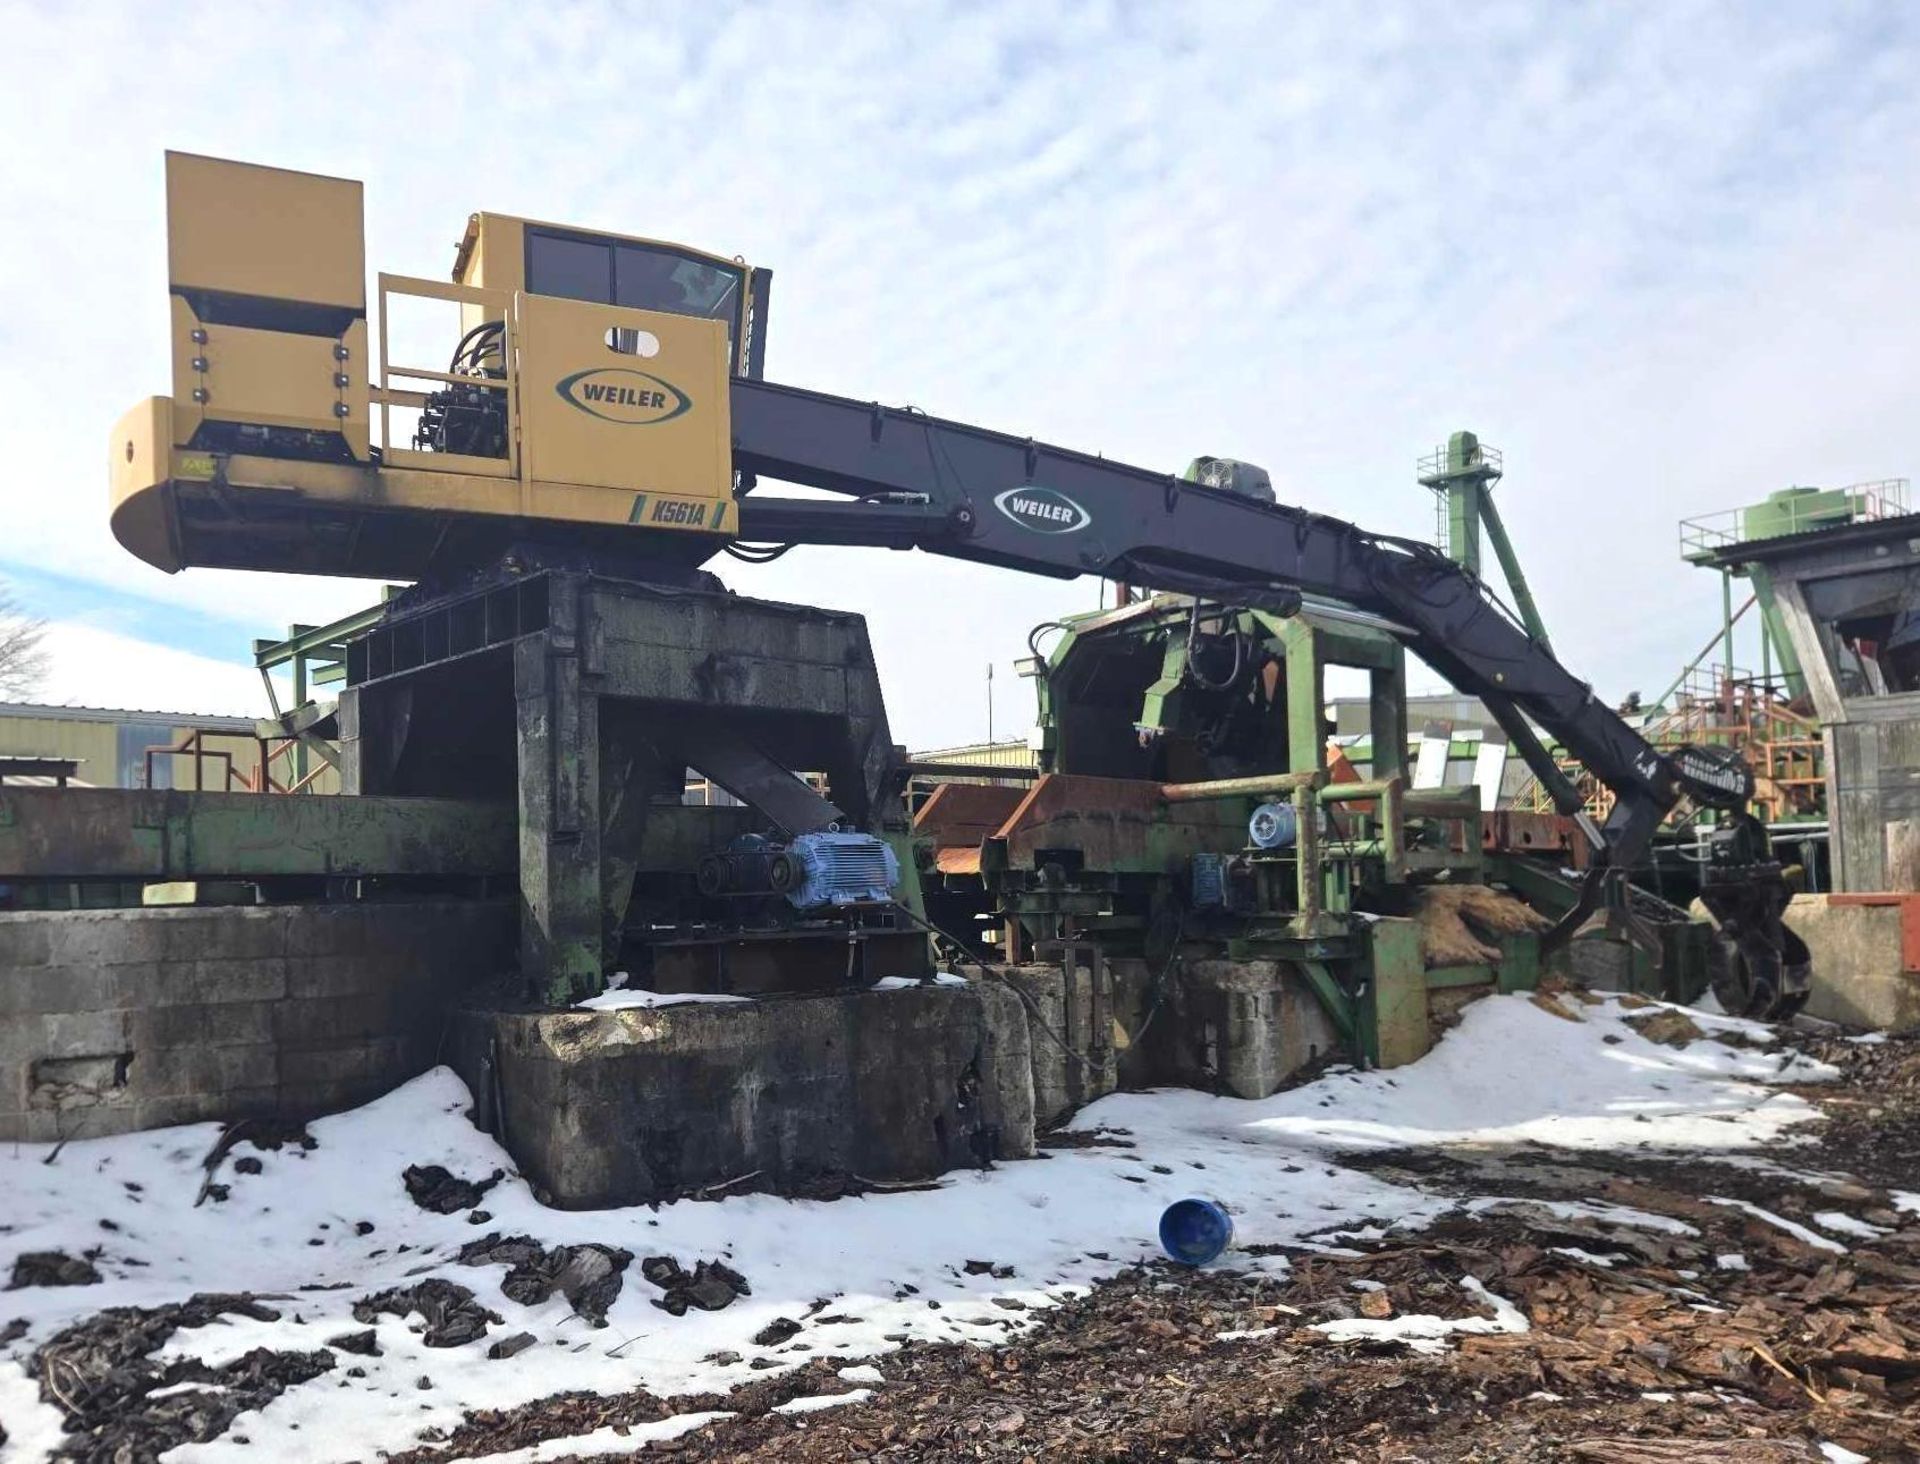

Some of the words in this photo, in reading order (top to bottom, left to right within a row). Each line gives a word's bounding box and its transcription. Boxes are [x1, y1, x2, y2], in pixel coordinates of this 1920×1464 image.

[583, 383, 666, 408] WEILER
[651, 500, 706, 525] K561A
[1012, 497, 1073, 523] WEILER
